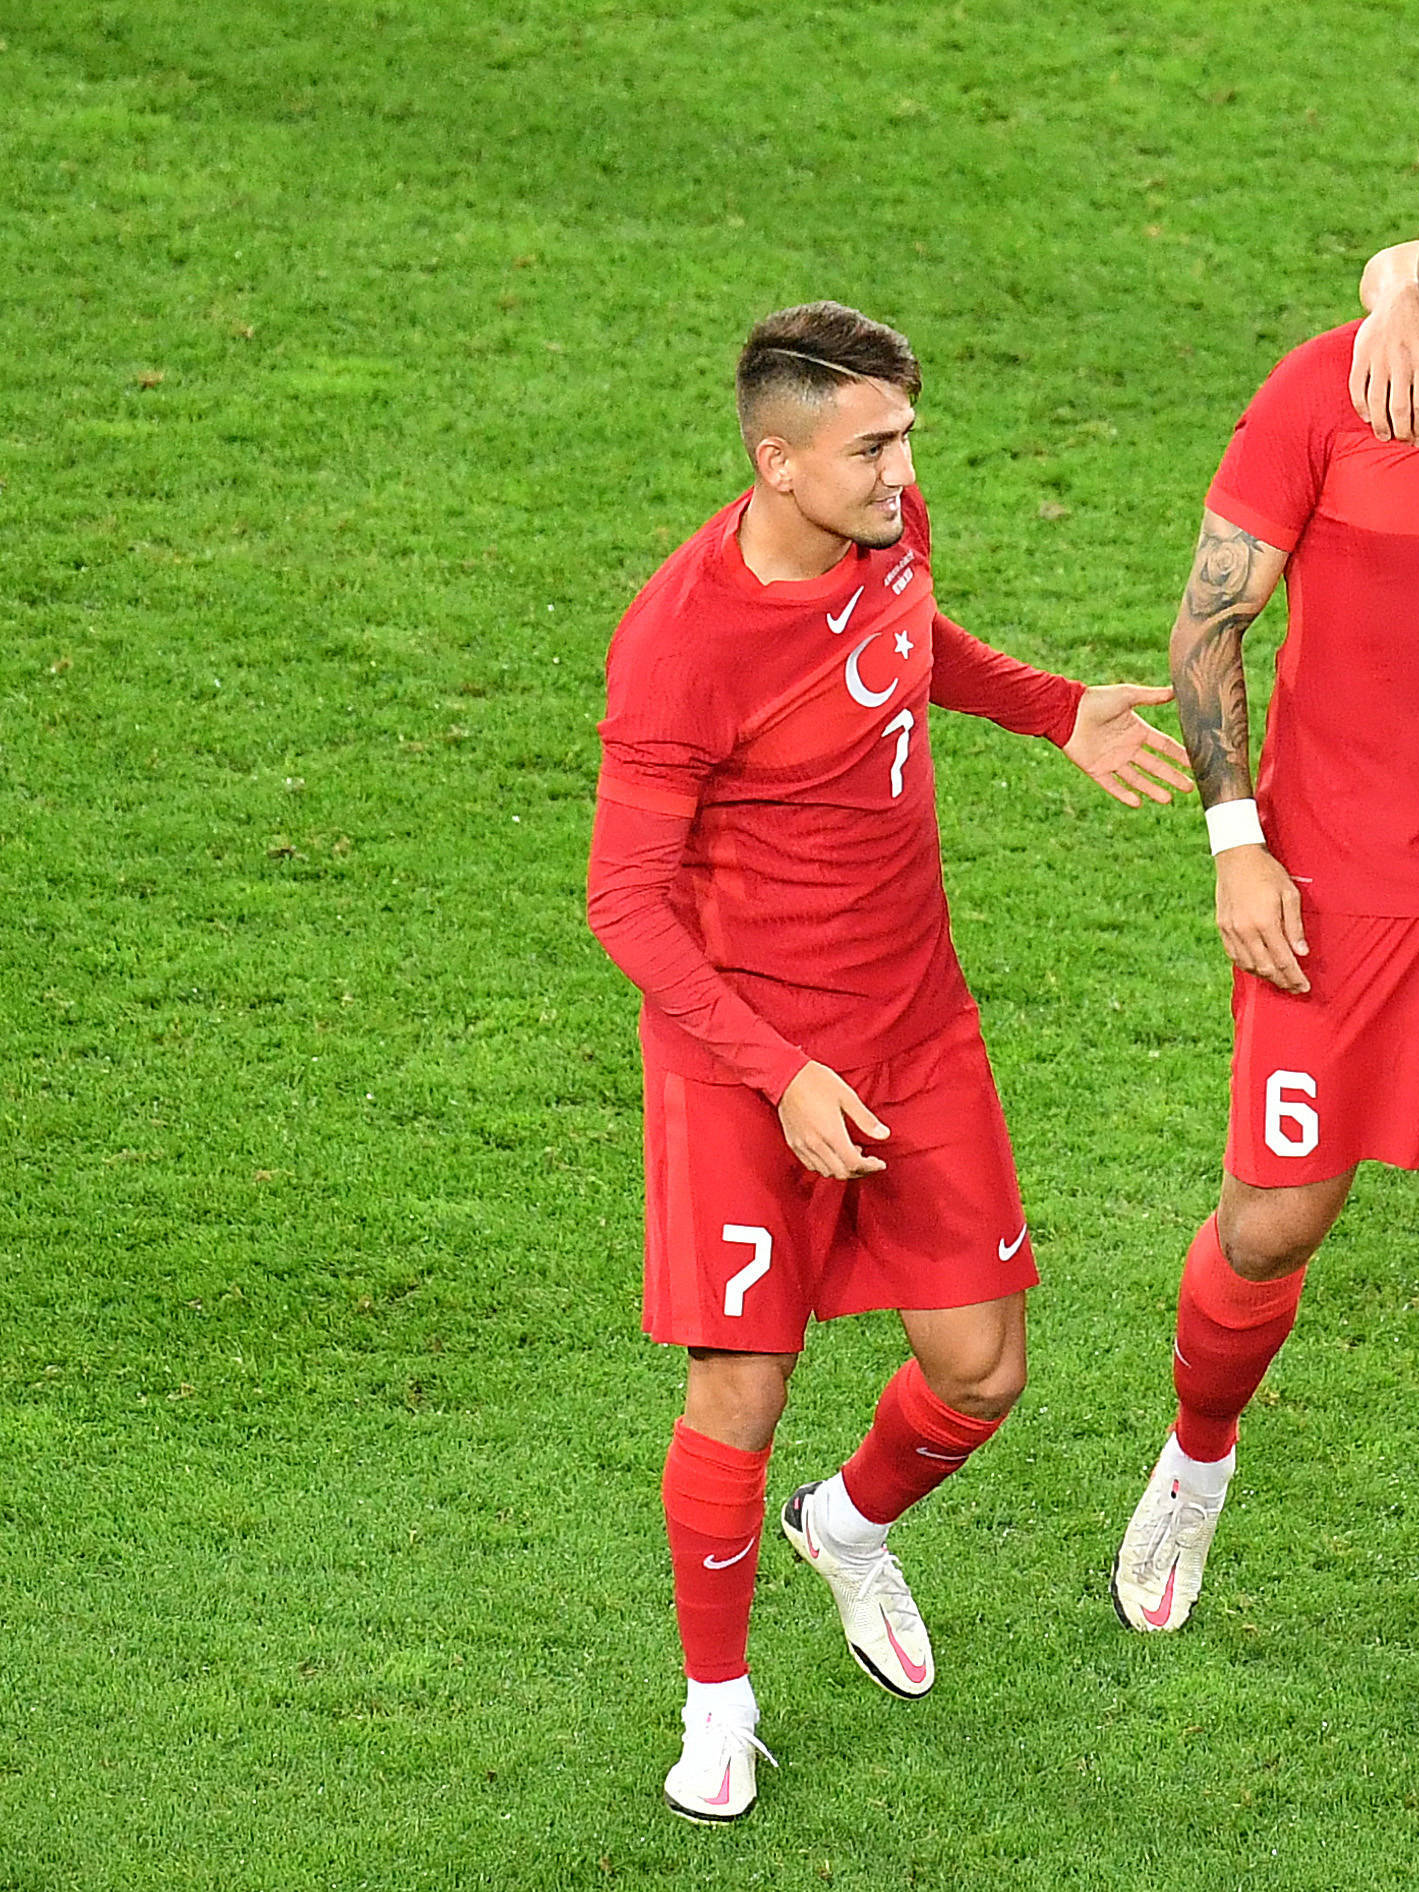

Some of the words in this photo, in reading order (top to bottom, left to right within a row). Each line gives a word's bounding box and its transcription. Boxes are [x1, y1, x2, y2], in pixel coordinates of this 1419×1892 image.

[881, 708, 914, 798] 7
[1264, 1069, 1319, 1157] 6
[722, 1224, 772, 1317] 7
